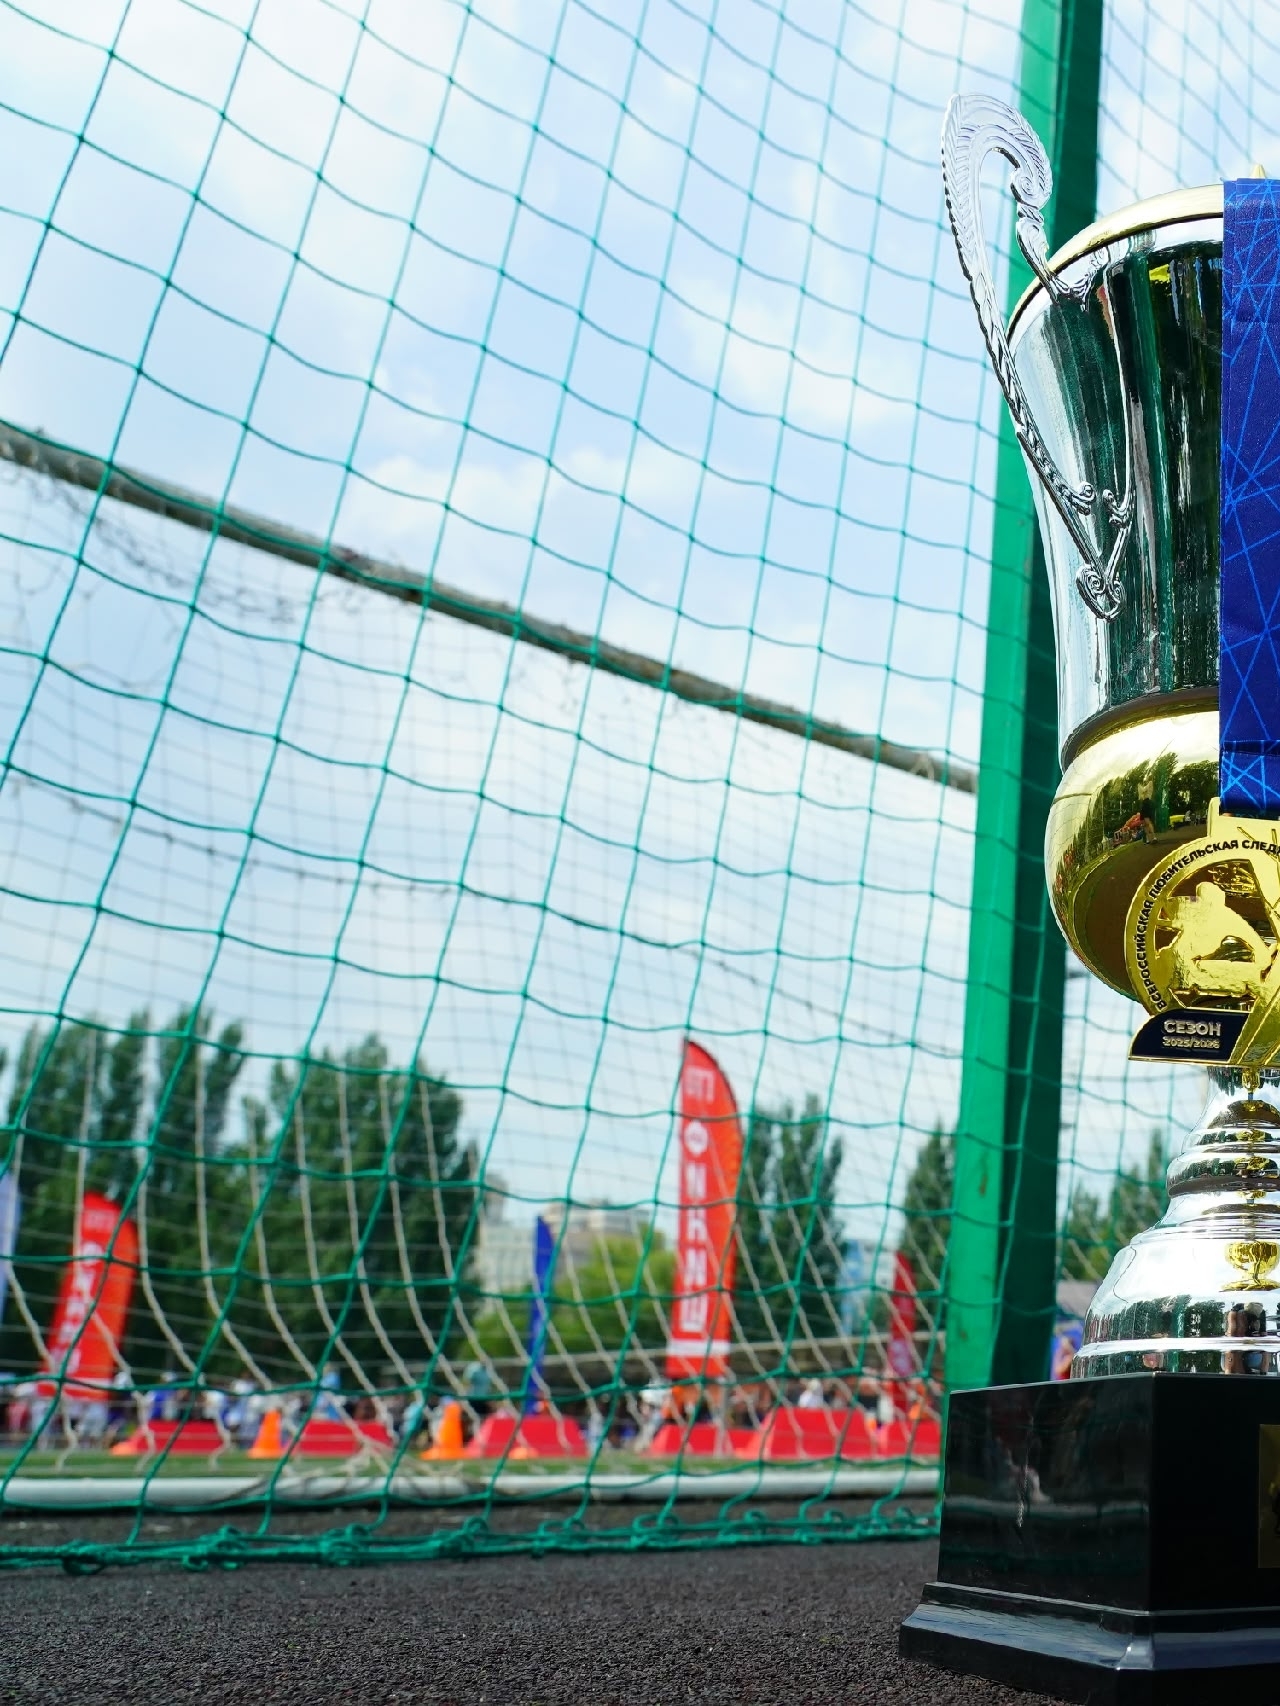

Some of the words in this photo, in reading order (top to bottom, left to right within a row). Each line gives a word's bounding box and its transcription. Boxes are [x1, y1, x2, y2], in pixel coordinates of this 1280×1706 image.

[1148, 839, 1239, 899] ЛЮБИТЕЛЬСКАЯ
[1133, 899, 1167, 1011] ВСЕРОССИЙСКАЯ
[1162, 1036, 1220, 1049] 2025/2026
[1163, 1018, 1222, 1037] СЕЗОН
